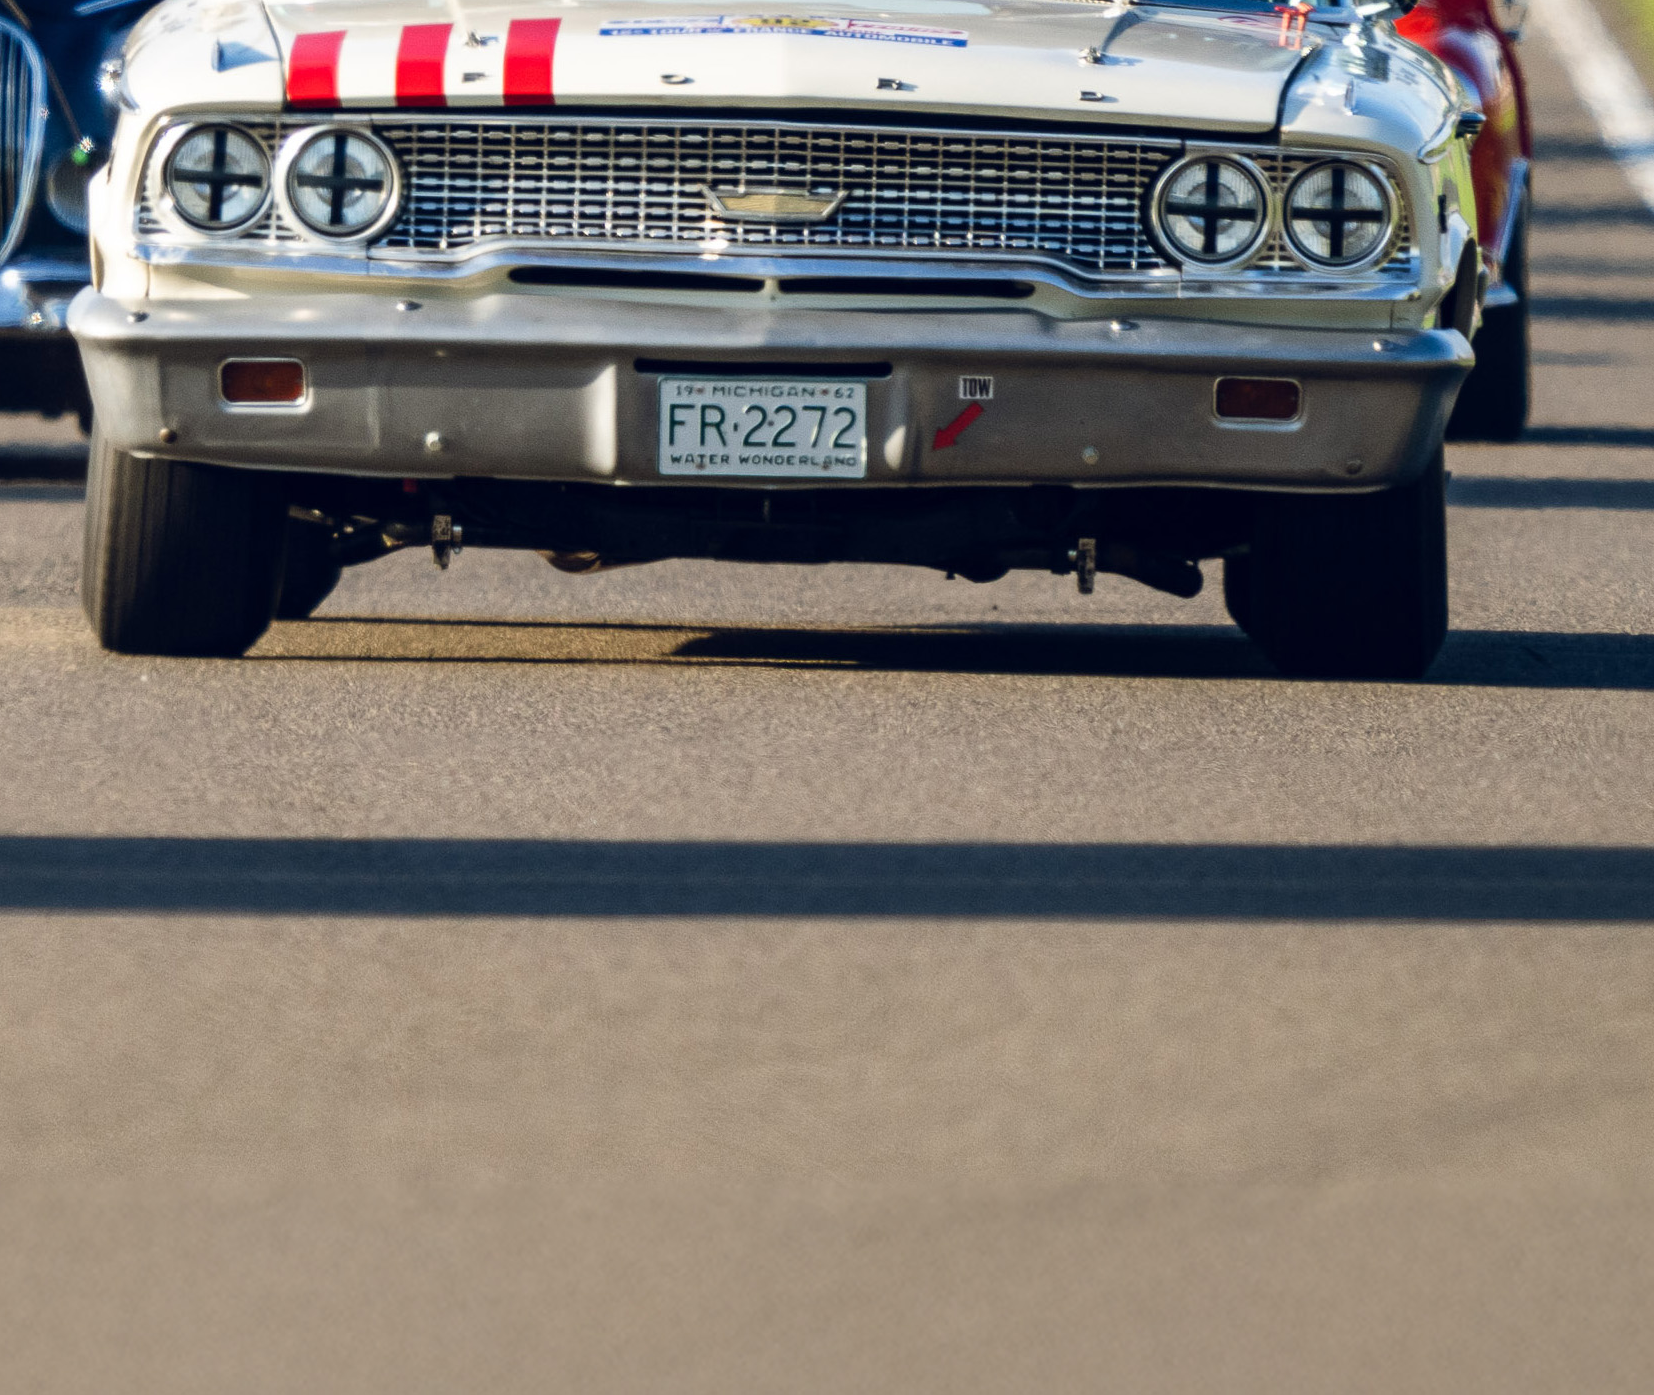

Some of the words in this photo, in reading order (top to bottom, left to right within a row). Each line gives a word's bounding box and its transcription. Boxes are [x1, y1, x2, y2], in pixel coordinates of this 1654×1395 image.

[712, 385, 815, 397] MICHIGAN
[833, 387, 855, 399] 62
[962, 377, 992, 398] TOW
[670, 453, 730, 465] WATER
[739, 454, 858, 467] WONDERLAND
